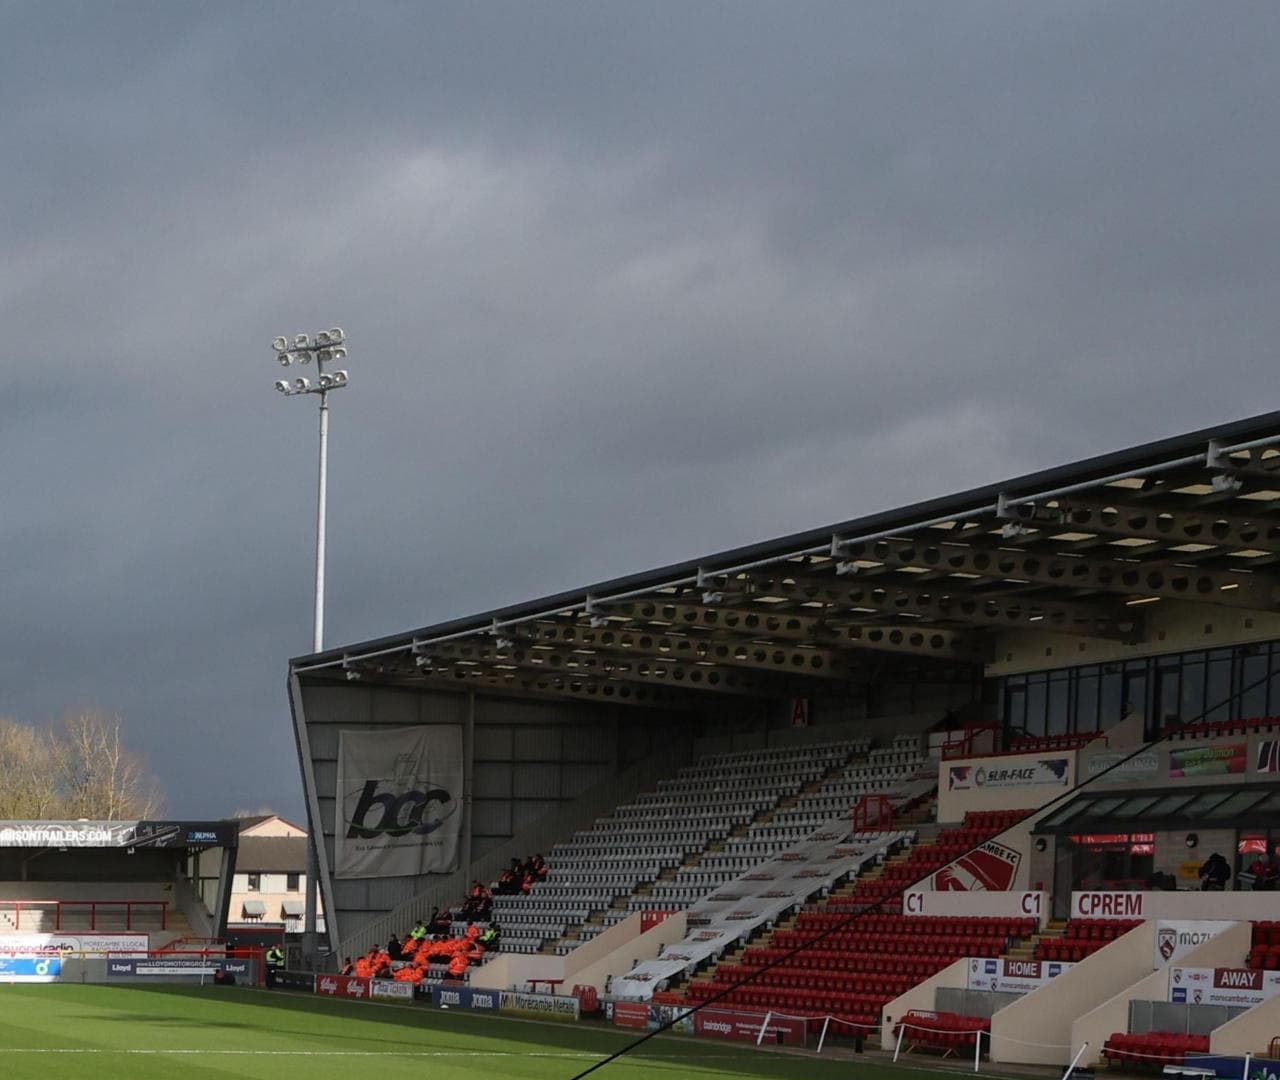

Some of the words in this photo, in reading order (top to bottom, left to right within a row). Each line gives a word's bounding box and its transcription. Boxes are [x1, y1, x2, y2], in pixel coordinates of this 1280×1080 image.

[347, 780, 451, 838] bcc
[1006, 853, 1017, 863] FC
[906, 894, 924, 912] C1
[1021, 894, 1040, 913] C1
[1079, 894, 1142, 915] CPREM
[112, 963, 132, 972] Lloyd
[226, 964, 245, 972] Lloyd
[1008, 962, 1038, 976] HOME
[1220, 971, 1257, 987] AWAY
[516, 995, 553, 1011] Morecambe
